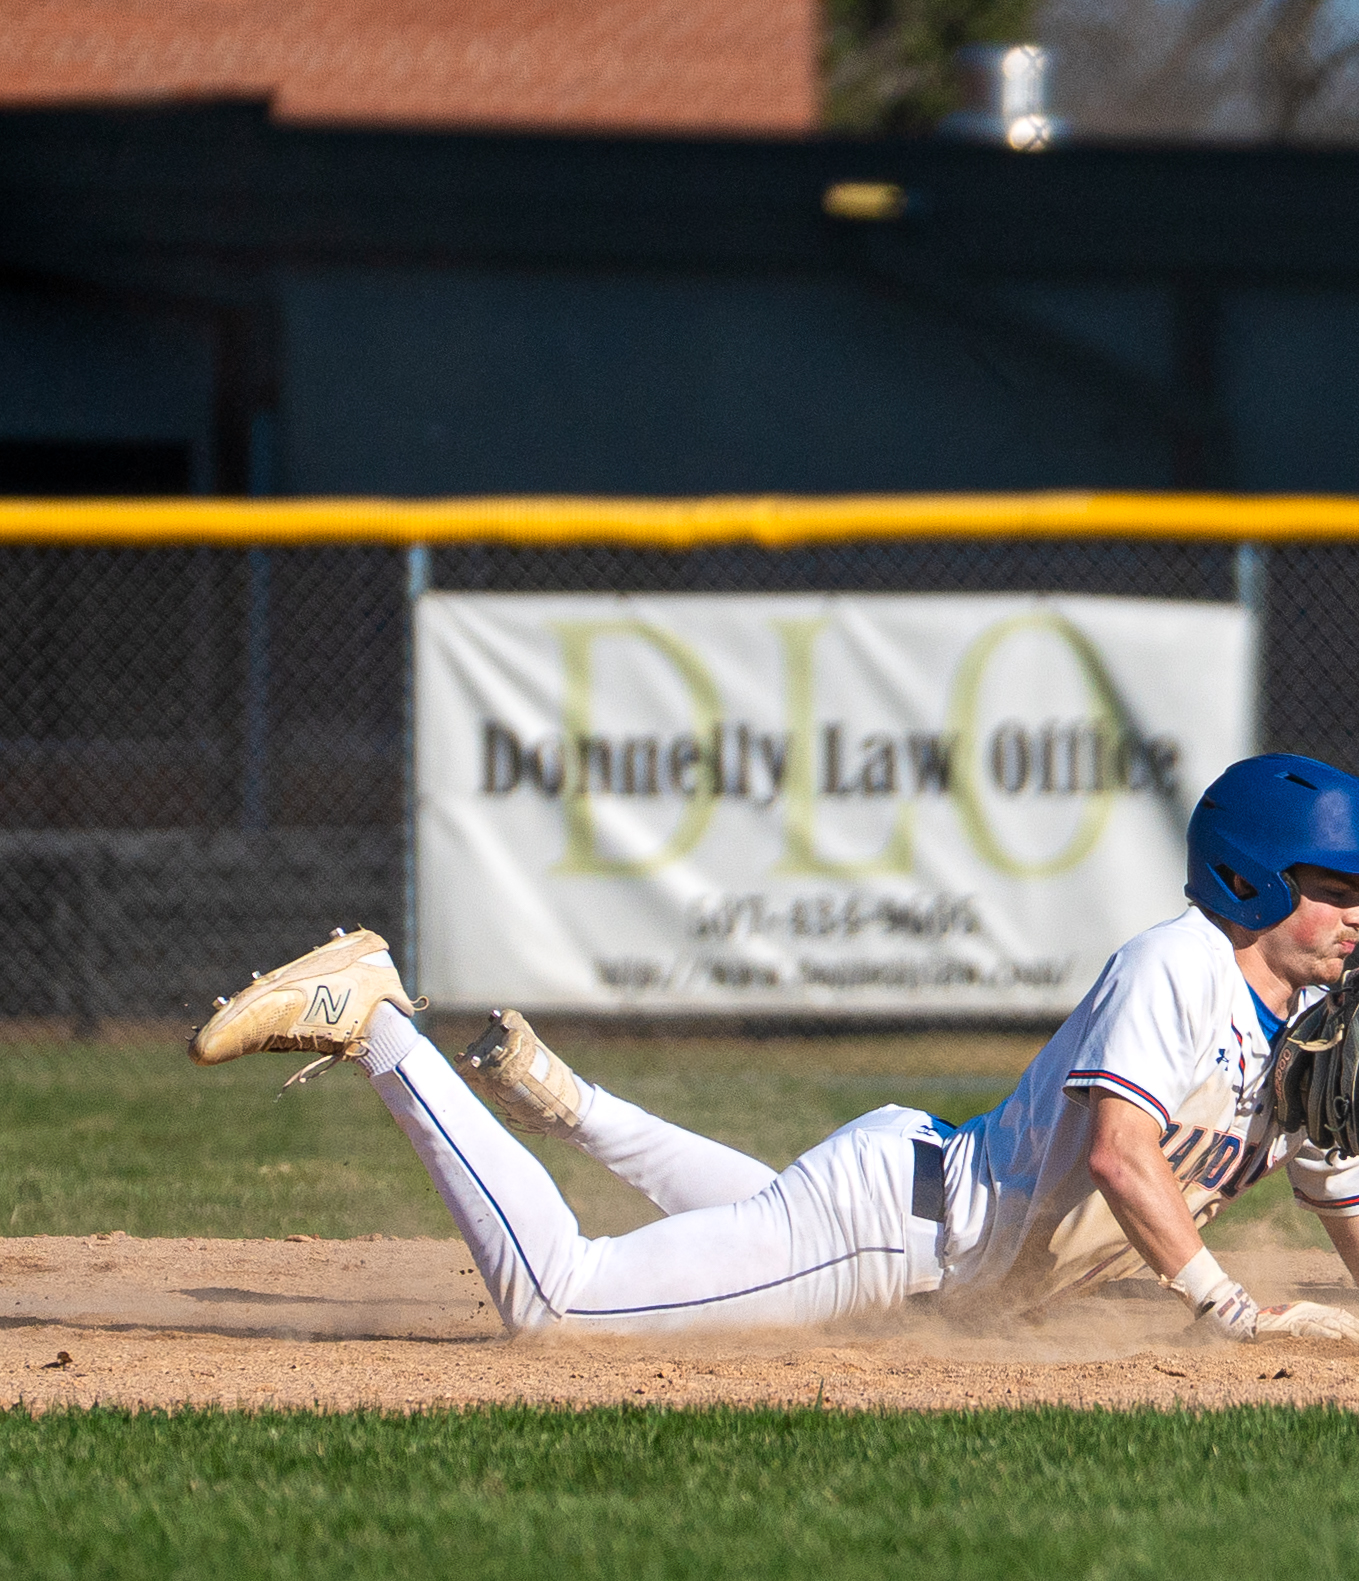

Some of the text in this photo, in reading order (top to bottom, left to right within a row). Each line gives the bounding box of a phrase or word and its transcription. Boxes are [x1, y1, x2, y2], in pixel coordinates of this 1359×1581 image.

[479, 718, 1182, 805] Donnelly Law Office
[550, 614, 1122, 880] DLO
[303, 985, 352, 1025] N
